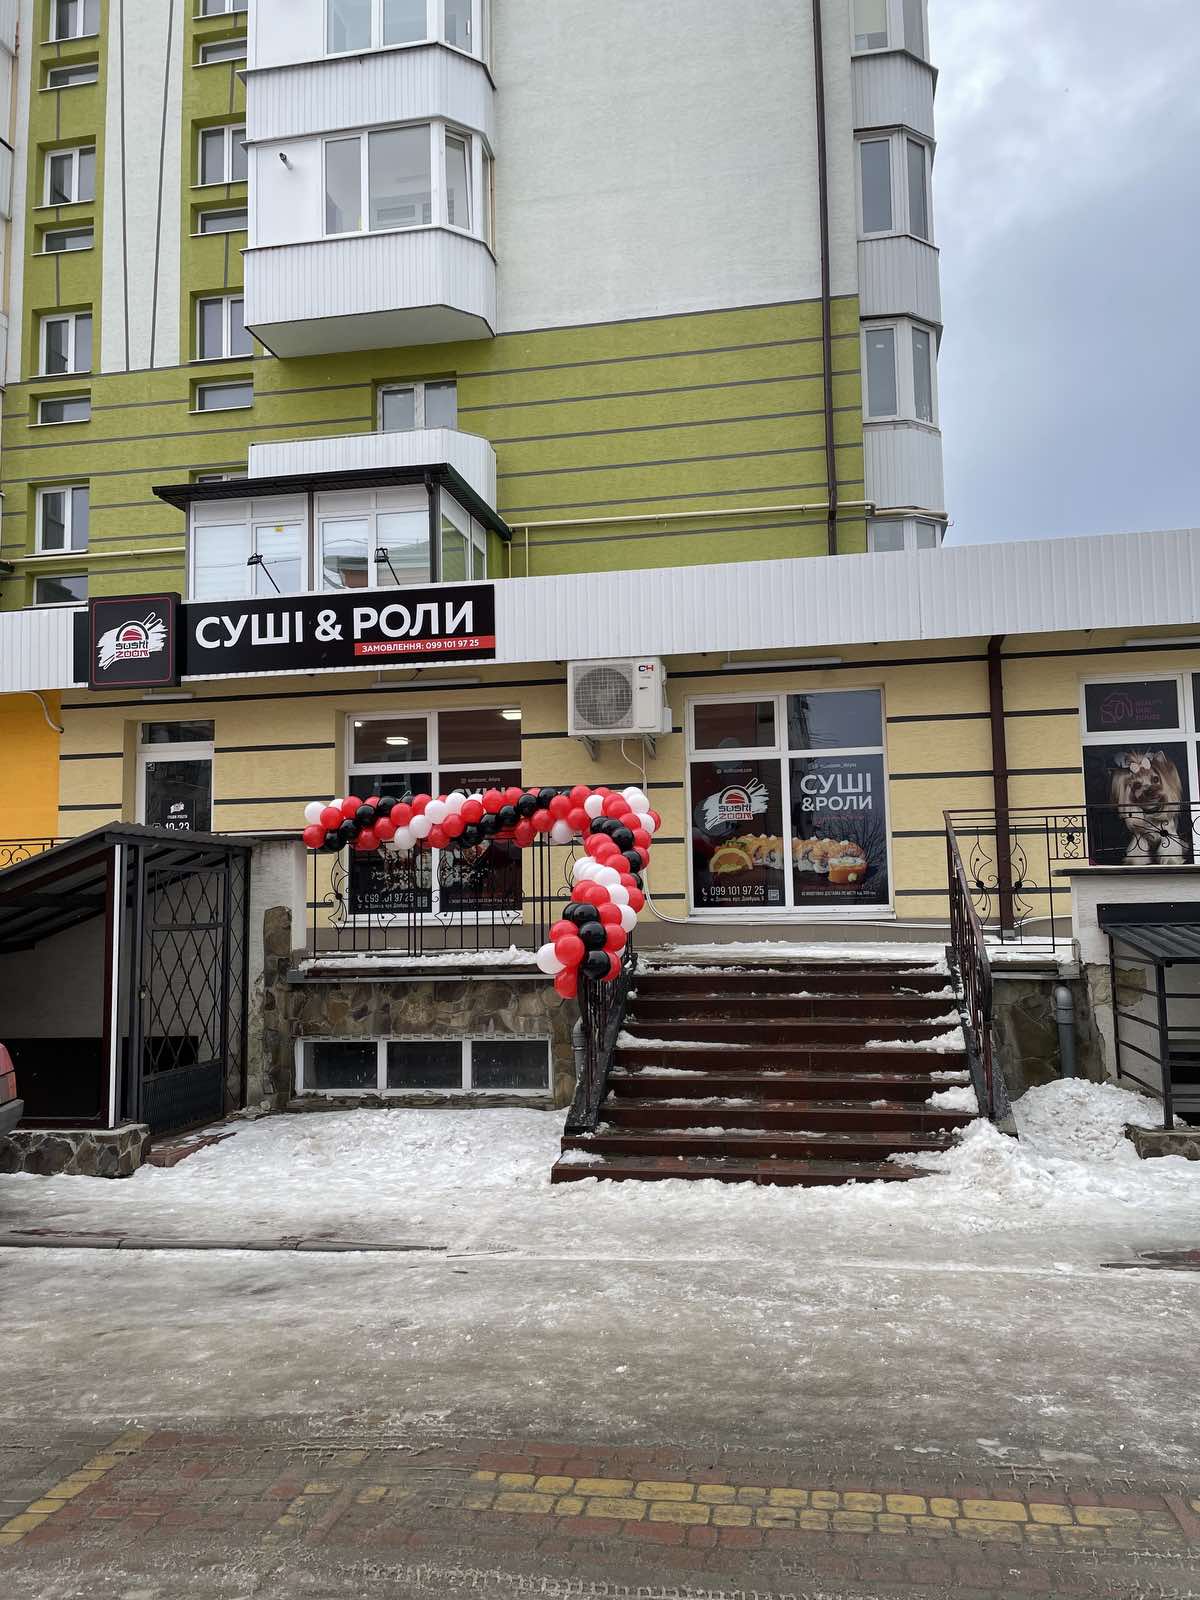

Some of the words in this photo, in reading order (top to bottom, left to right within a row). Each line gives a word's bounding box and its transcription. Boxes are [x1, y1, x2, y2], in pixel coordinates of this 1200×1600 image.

[195, 611, 304, 649] СУШІ
[314, 609, 344, 642] &
[353, 600, 474, 640] РОЛИ
[361, 643, 424, 653] ЗАМОВЛЕННЯ:
[425, 641, 442, 650] 099
[444, 640, 456, 648] 101
[458, 640, 467, 648] 97
[469, 639, 479, 647] 25
[800, 773, 872, 794] СУШІ
[801, 795, 873, 811] &РОЛИ
[710, 886, 726, 896] 099
[728, 886, 740, 895] 101
[742, 885, 752, 895] 97
[754, 885, 765, 895] 25
